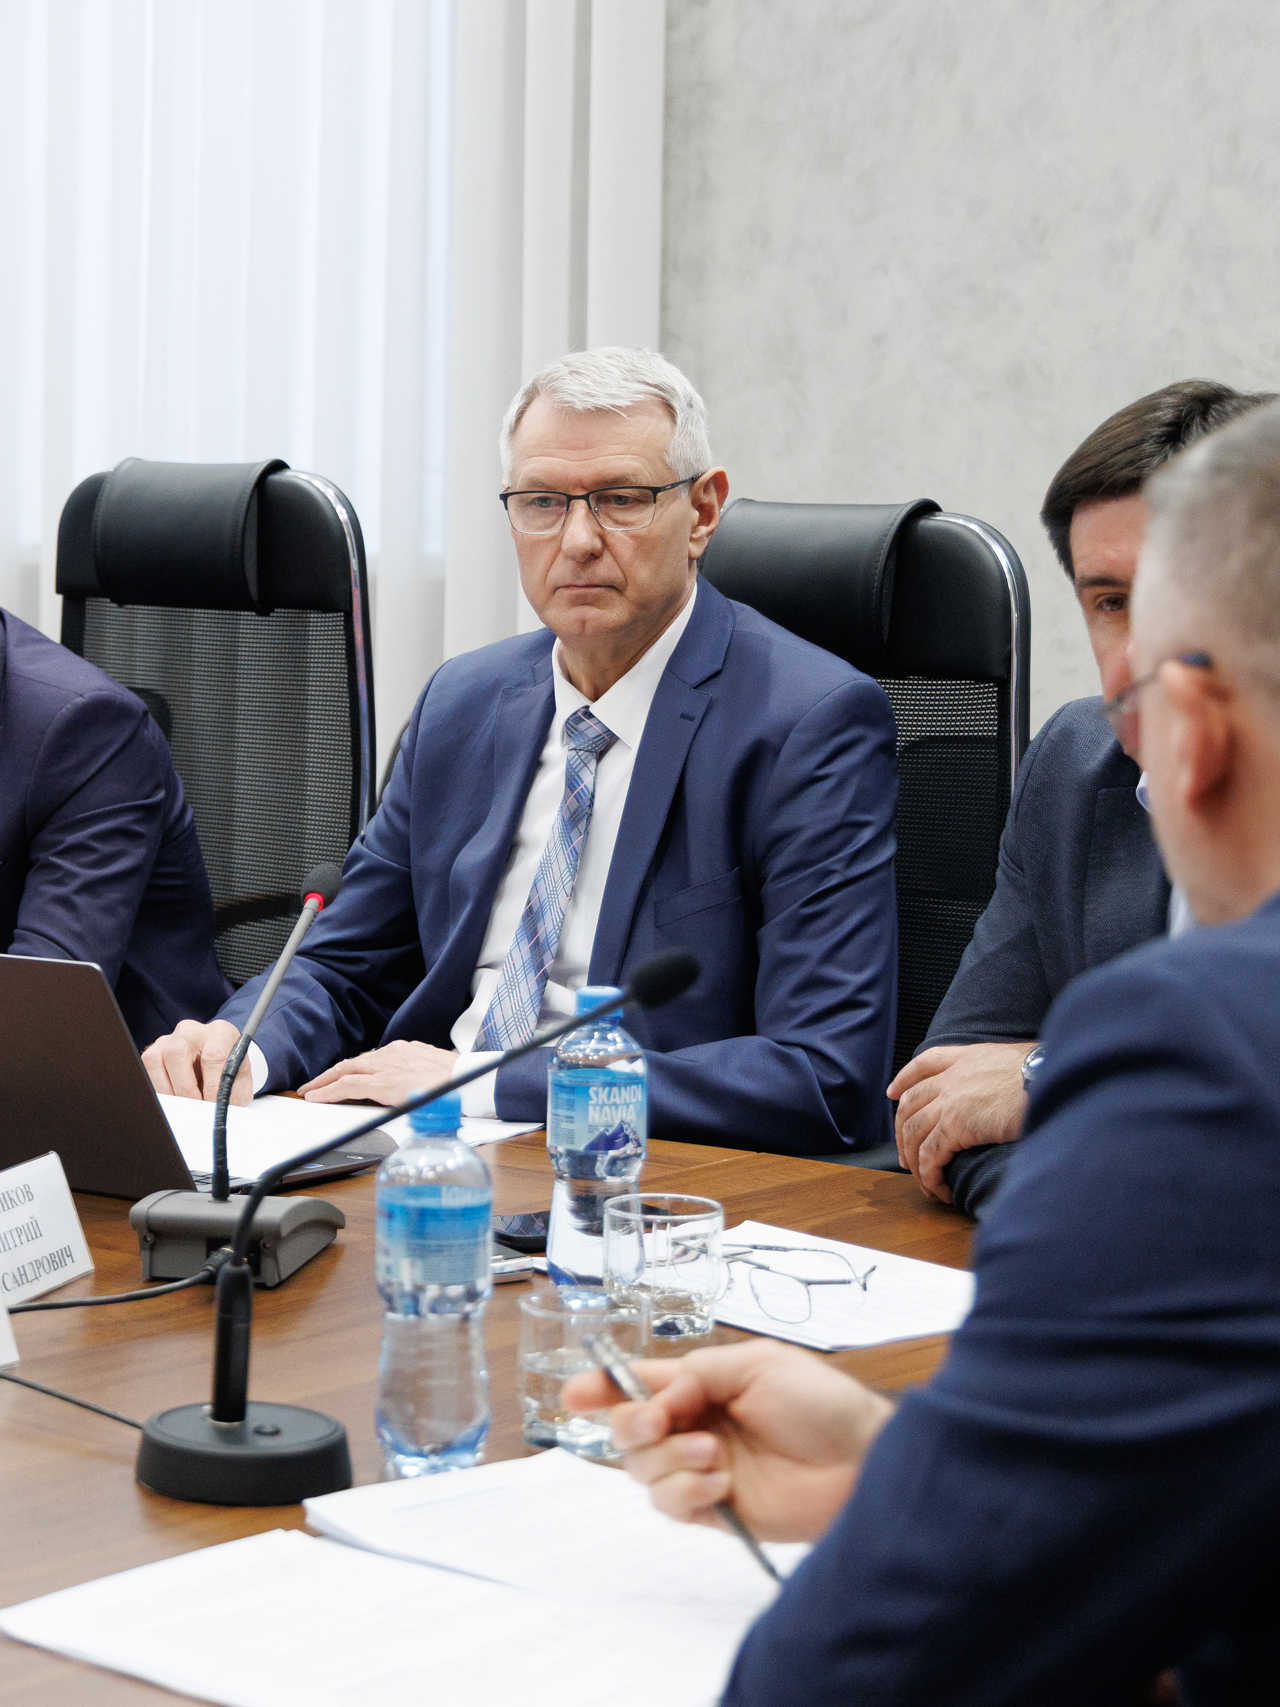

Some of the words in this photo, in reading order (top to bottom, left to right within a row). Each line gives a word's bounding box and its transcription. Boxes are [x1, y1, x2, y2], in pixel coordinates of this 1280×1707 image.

[588, 1084, 642, 1104] SKANDI
[587, 1103, 636, 1123] NAVIA
[0, 1245, 76, 1293] САНДРОВИЧ
